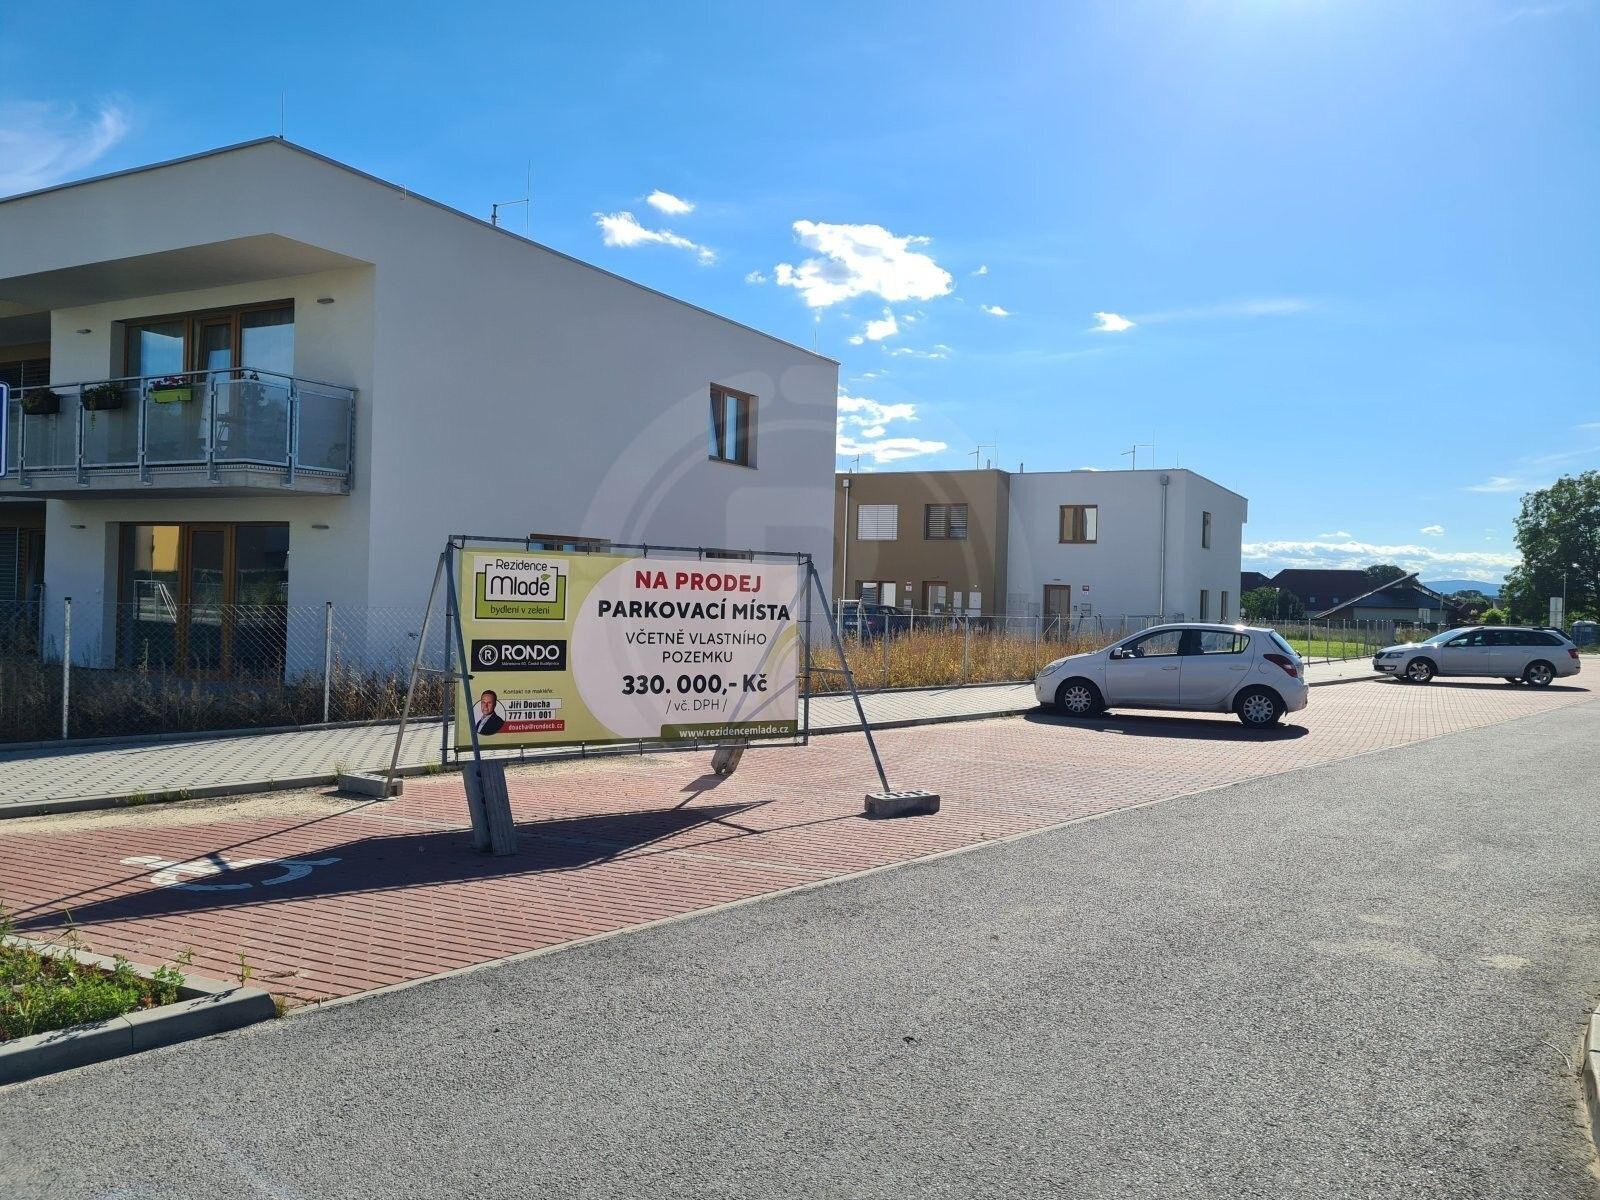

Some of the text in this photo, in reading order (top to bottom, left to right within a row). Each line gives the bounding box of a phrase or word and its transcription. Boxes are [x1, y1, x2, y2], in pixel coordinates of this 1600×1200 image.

[495, 558, 548, 572] Rezidence
[635, 570, 762, 593] NA PRODEJ
[598, 598, 791, 621] PARKOVACÍ MÍSTA
[625, 628, 767, 646] VČETNĚ VLASTNÍHO
[501, 644, 560, 661] RONDO
[662, 650, 733, 664] POZEMKU
[621, 673, 768, 696] 330. 000,- Kč
[508, 700, 551, 709] Jiří Doucha
[674, 700, 690, 712] vč.
[693, 698, 720, 712] DPH
[508, 710, 552, 720] 777 101 001
[679, 723, 789, 739] www.rezidencemlade.cz
